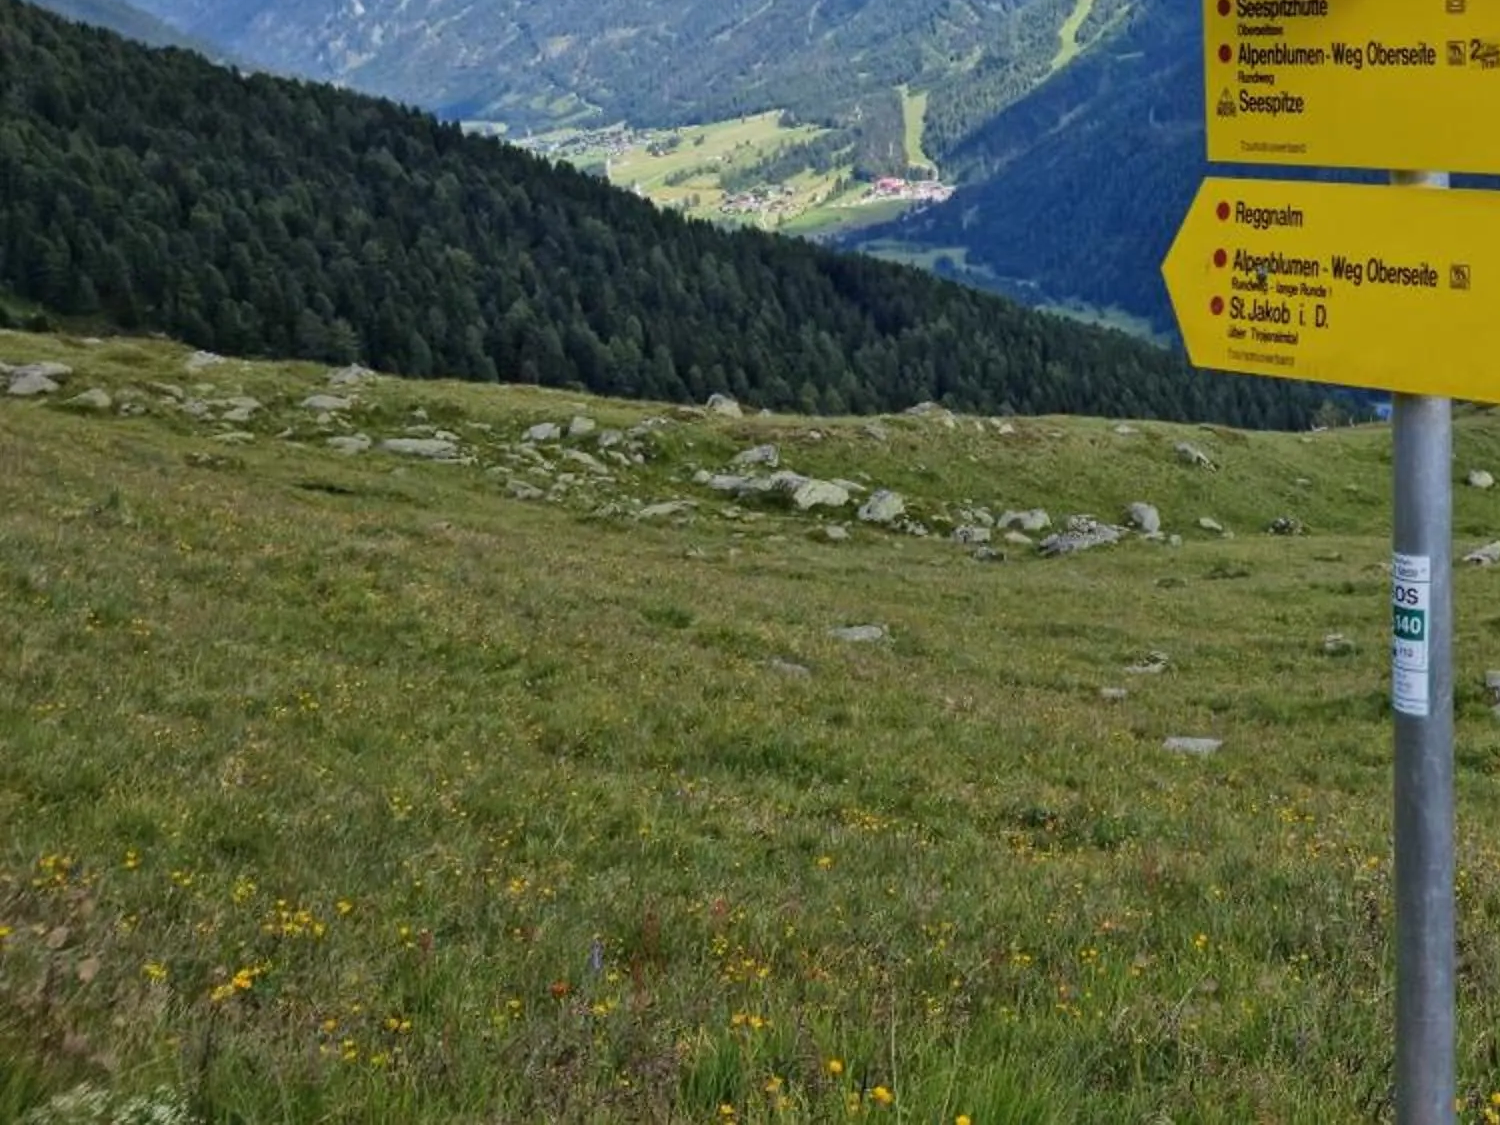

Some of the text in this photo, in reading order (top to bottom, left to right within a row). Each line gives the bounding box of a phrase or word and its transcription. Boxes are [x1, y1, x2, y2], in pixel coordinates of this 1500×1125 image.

[1367, 42, 1436, 65] Oberseite
[1239, 90, 1304, 116] Seespitze
[1235, 201, 1303, 230] Reggnalm
[1332, 255, 1362, 286] Weg
[1367, 258, 1438, 287] Oberseite
[1300, 283, 1327, 298] Runde
[1315, 304, 1329, 329] D.
